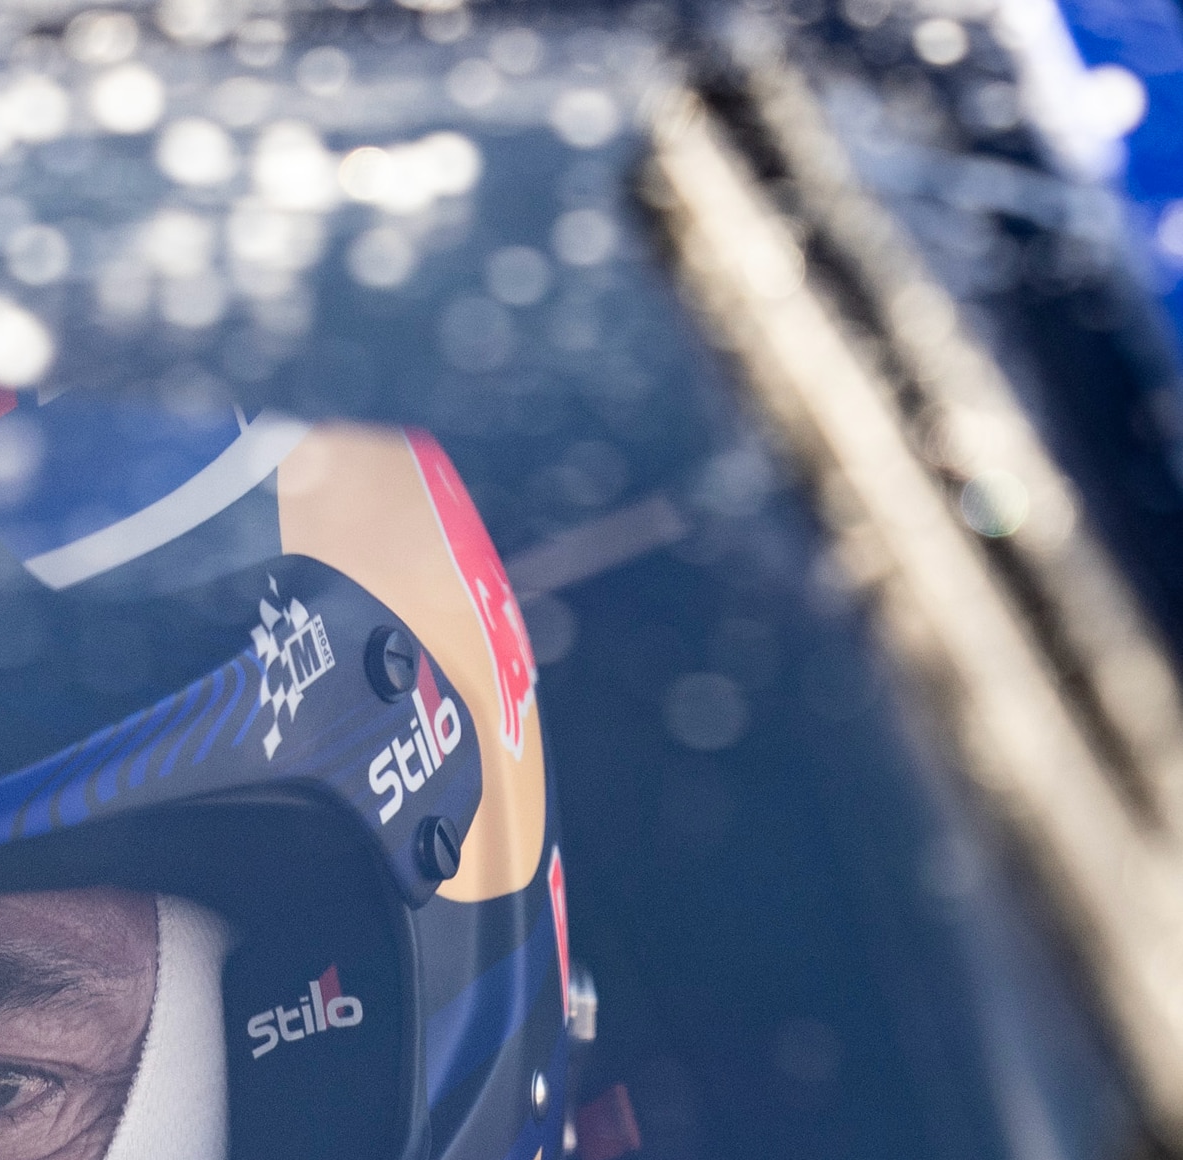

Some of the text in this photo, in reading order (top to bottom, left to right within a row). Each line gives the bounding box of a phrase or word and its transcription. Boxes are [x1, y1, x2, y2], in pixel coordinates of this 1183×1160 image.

[288, 628, 322, 687] M
[315, 619, 334, 666] SPORT
[368, 687, 462, 826] Stilo
[247, 978, 364, 1060] Stilo
